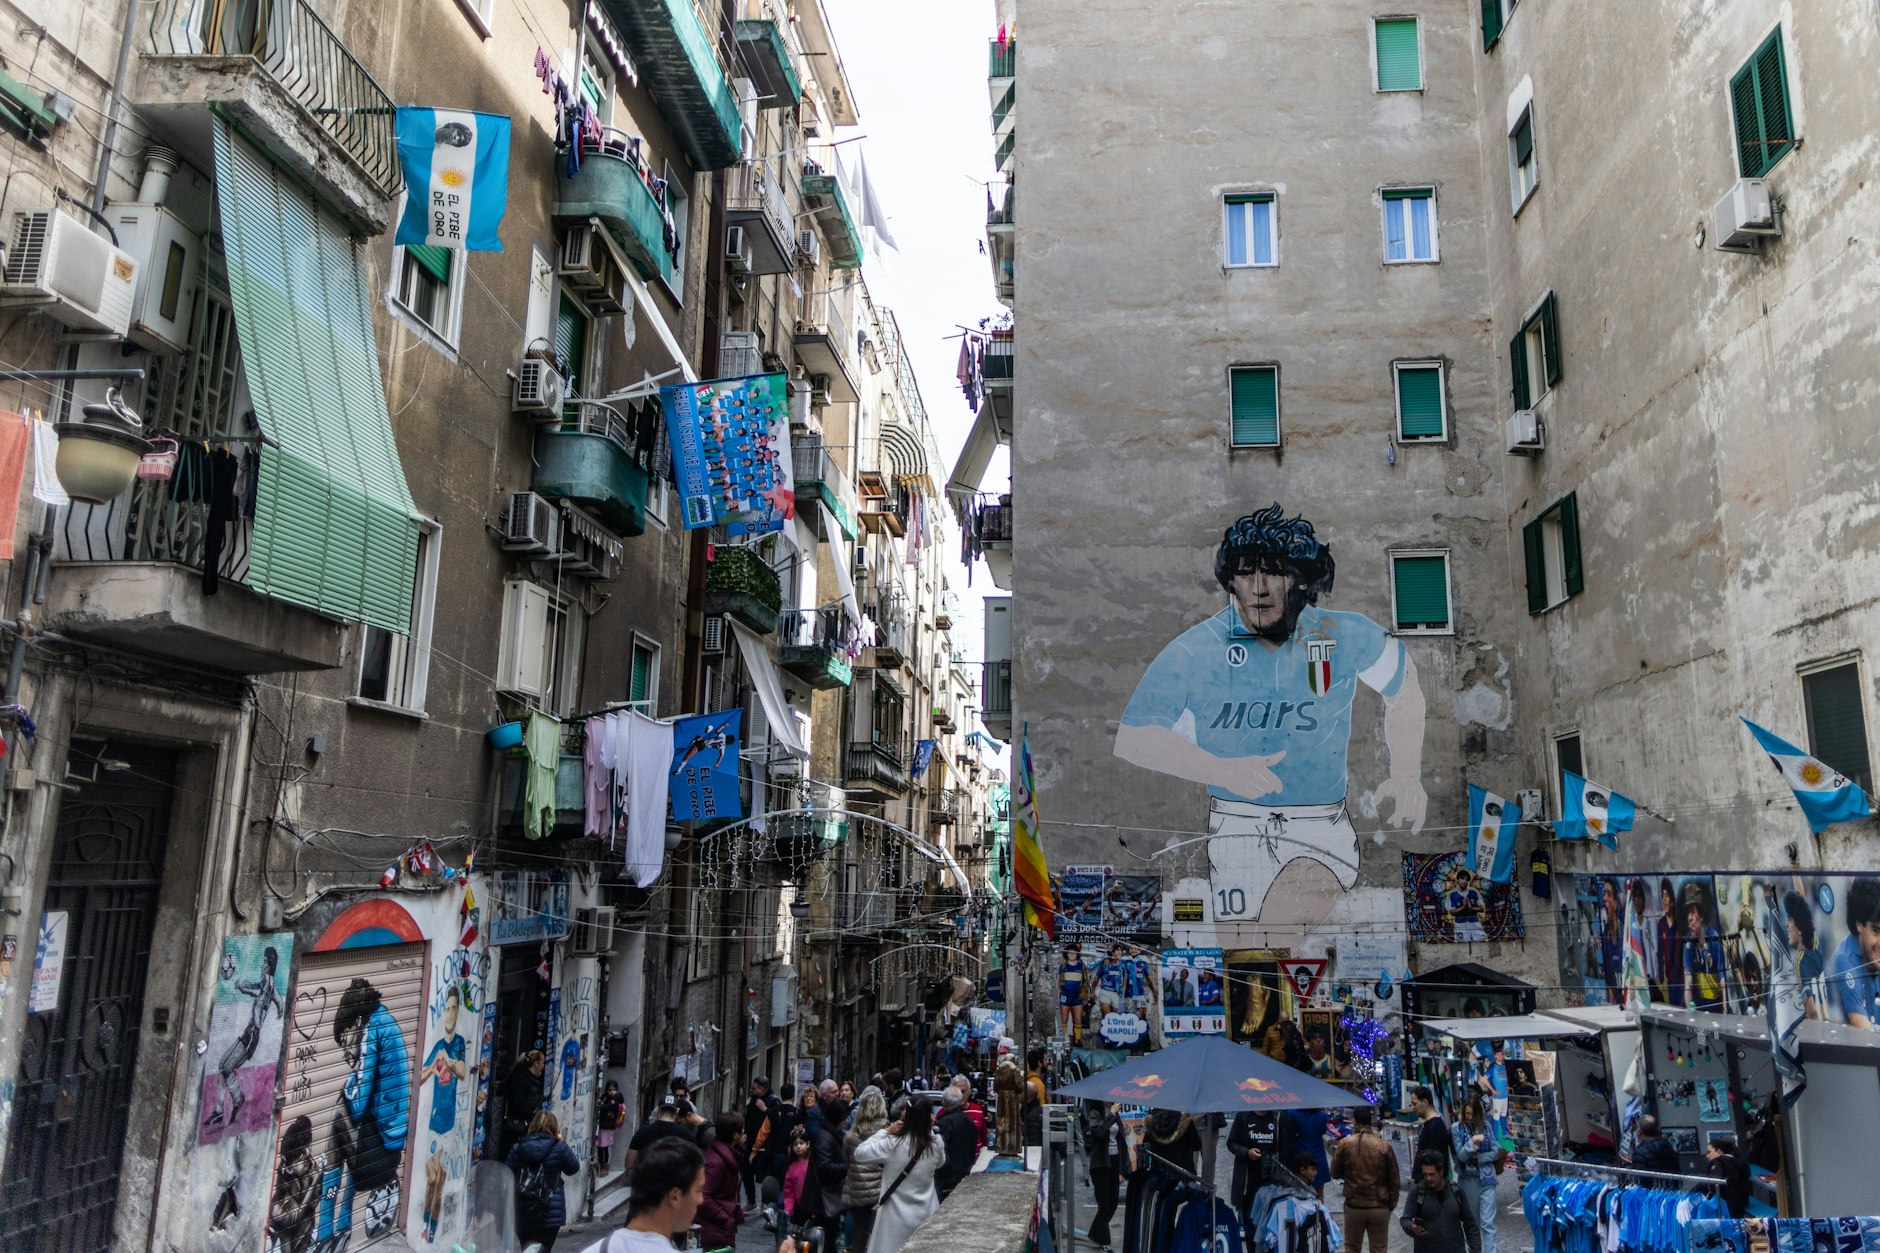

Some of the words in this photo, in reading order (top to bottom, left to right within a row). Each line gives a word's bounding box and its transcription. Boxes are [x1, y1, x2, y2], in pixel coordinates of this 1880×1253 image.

[433, 191, 445, 207] DE
[448, 193, 460, 207] EL
[434, 210, 445, 237] ORO
[449, 211, 460, 240] PIBE
[673, 387, 691, 417] ABBIAMO
[679, 417, 694, 429] UN
[681, 429, 699, 454] SOGNO
[685, 454, 701, 469] NEL
[687, 469, 704, 496] CUORE
[1208, 700, 1319, 732] Mars
[685, 768, 697, 785] DE
[700, 767, 711, 782] EL
[689, 790, 701, 819] ORO
[702, 786, 716, 817] PIBE
[1218, 888, 1246, 916] 10
[1061, 924, 1079, 932] LOS
[1098, 925, 1137, 934] MEJORES
[1059, 935, 1077, 943] SON
[1107, 1027, 1137, 1036] NAPOLI!
[1250, 1129, 1274, 1140] indeed
